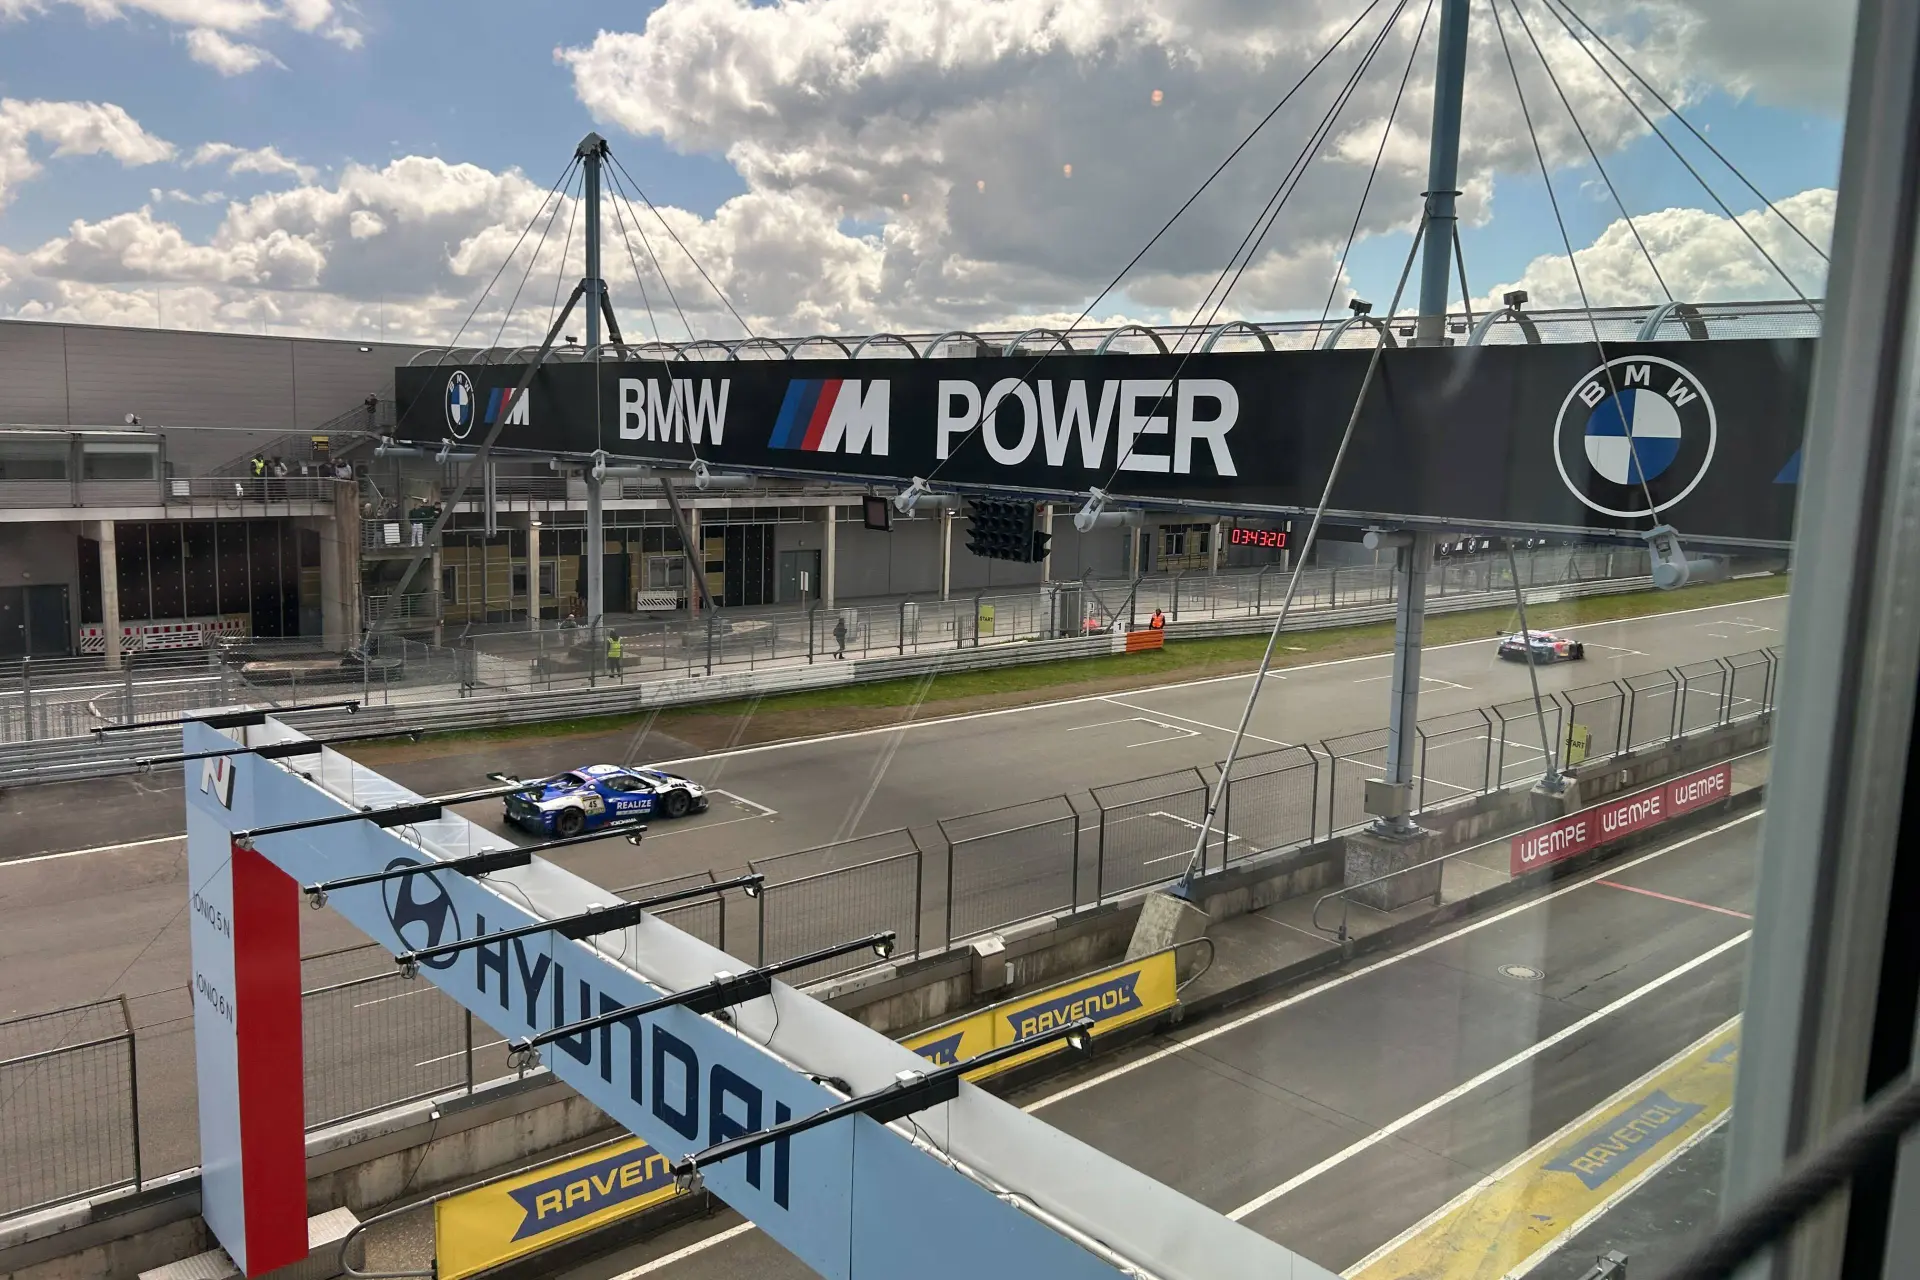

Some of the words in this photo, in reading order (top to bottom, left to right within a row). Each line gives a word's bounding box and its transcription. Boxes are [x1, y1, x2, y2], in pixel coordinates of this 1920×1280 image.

[448, 374, 471, 393] BMW
[1579, 364, 1698, 408] BMW
[619, 378, 730, 446] BMW
[818, 379, 891, 456] M
[936, 378, 1240, 477] POWER
[979, 615, 994, 623] START
[588, 801, 598, 809] 45
[616, 799, 652, 810] REALIZE
[1675, 772, 1725, 805] WEMPE
[1603, 795, 1660, 832] WEMPE
[1521, 821, 1586, 863] WEMPE
[193, 890, 216, 930] IONIQ
[217, 911, 222, 931] 5
[223, 917, 230, 939] N
[196, 970, 219, 1012] IONIQ
[219, 995, 225, 1015] 6
[226, 1001, 233, 1024] N
[1021, 987, 1131, 1038] RAVENOL
[476, 913, 792, 1211] HYUNDAI
[1568, 1104, 1683, 1175] RAVENOL
[535, 1153, 671, 1220] RAVEN
